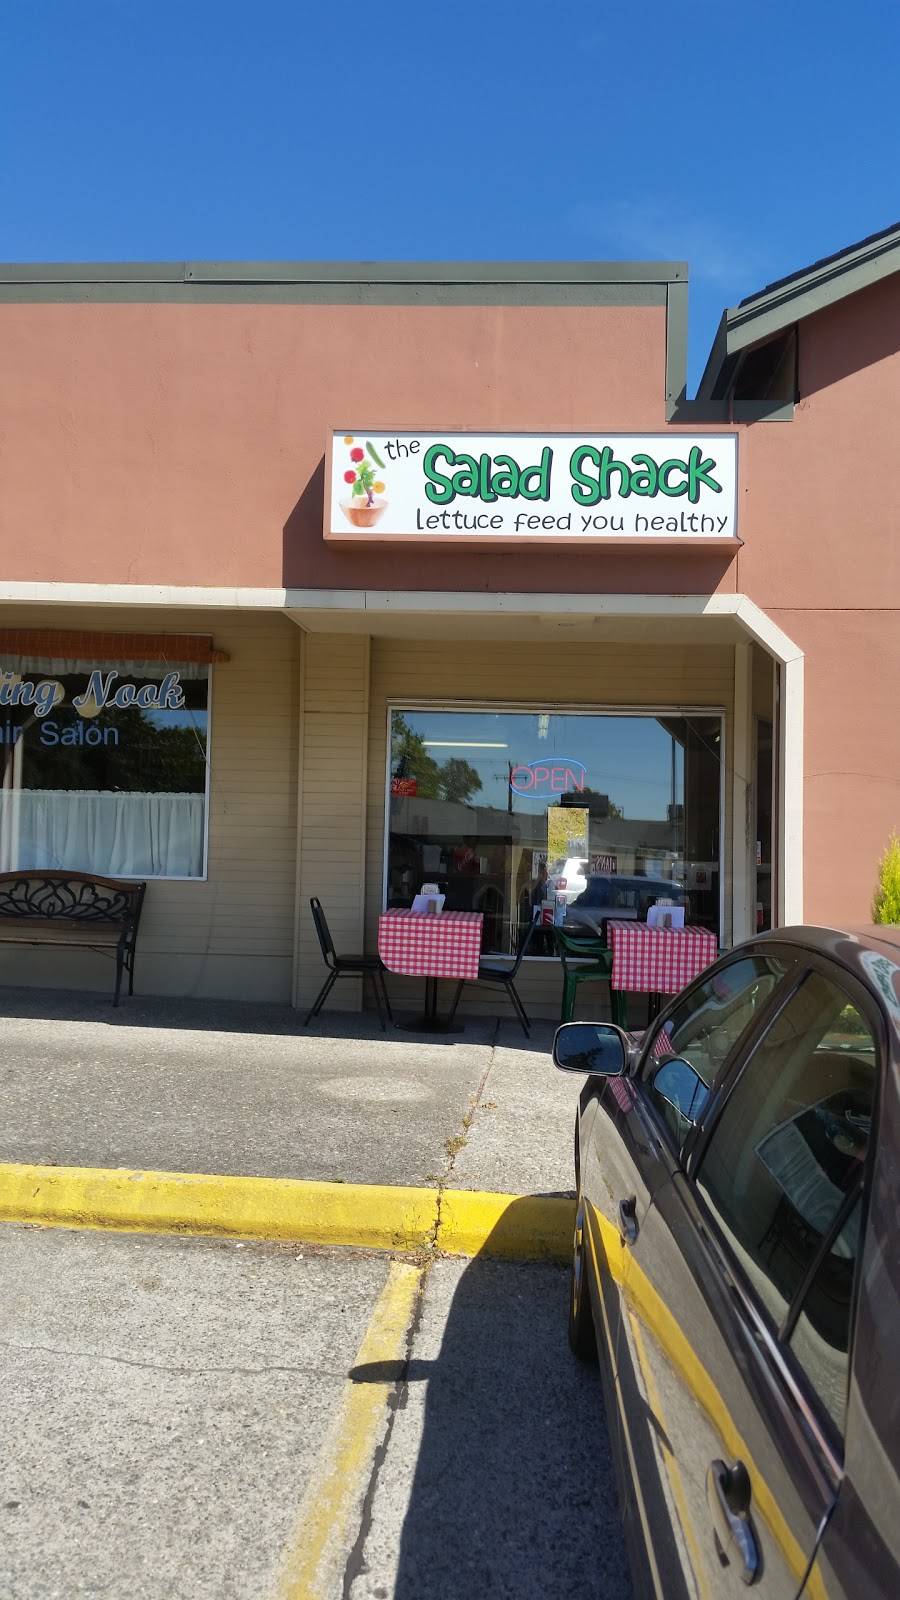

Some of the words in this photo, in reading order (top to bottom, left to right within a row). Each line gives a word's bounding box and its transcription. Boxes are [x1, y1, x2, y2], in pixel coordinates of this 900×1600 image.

[384, 439, 421, 461] the
[423, 443, 553, 505] Salad
[569, 445, 723, 506] Shack
[416, 508, 504, 530] lettuce
[514, 511, 572, 531] feed
[581, 515, 624, 532] you
[634, 512, 728, 533] healthy
[72, 670, 186, 709] Nook
[510, 766, 585, 793] OPEN
